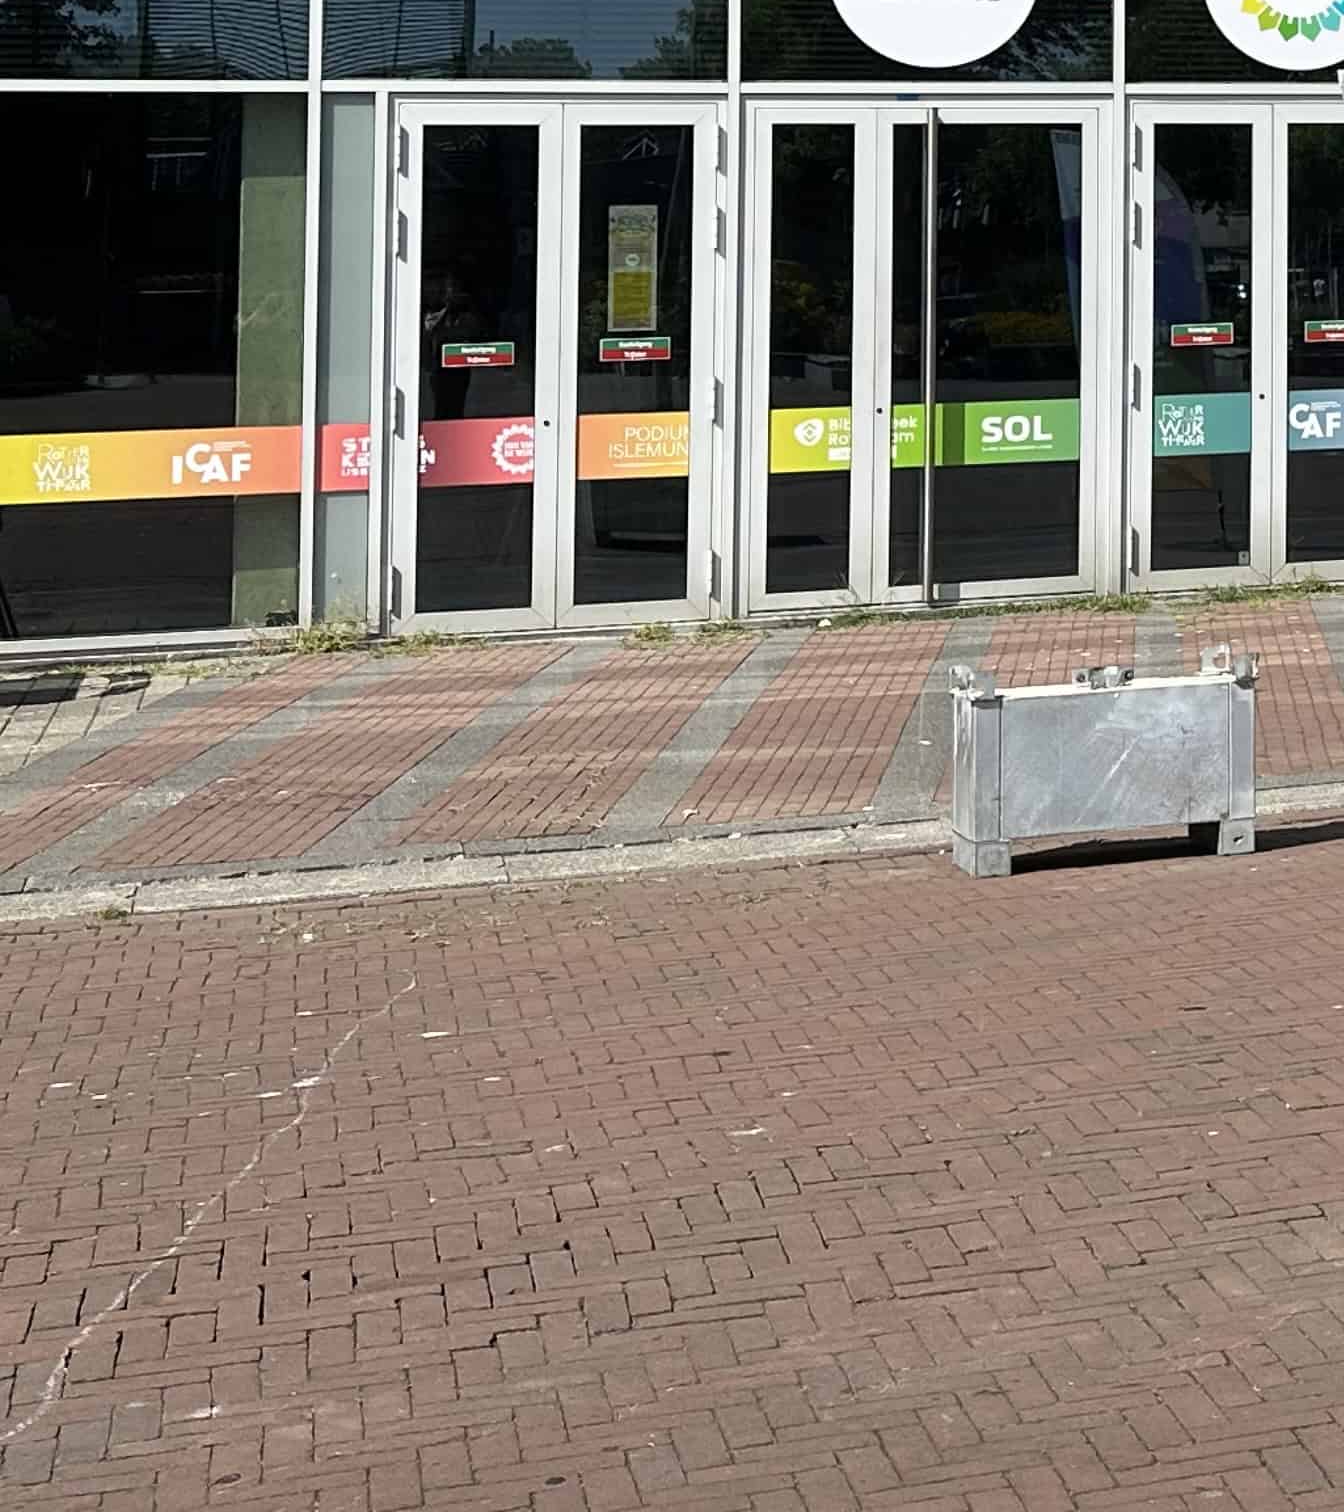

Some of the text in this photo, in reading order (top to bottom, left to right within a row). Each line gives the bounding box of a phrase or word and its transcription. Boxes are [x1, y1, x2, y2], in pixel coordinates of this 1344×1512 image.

[981, 415, 1053, 443] SOL
[1288, 402, 1342, 439] CAF
[172, 443, 252, 485] ICAF
[608, 441, 689, 460] ISLEMUN
